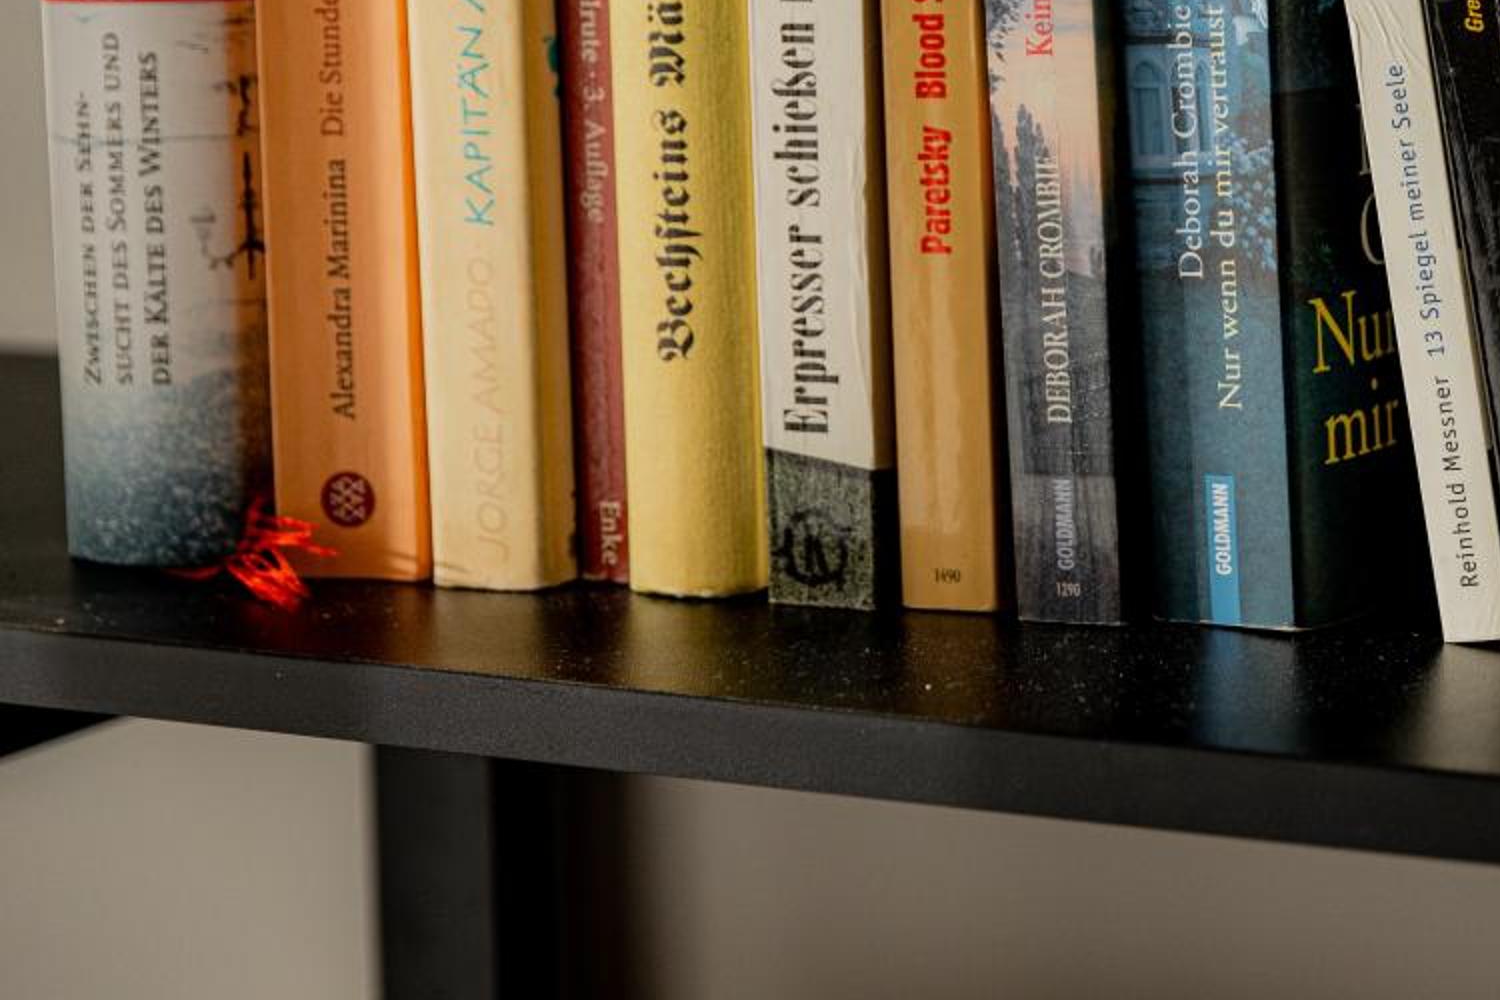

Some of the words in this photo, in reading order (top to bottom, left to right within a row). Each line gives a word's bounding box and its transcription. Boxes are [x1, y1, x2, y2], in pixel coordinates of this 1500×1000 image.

[101, 33, 121, 91] UND
[912, 14, 946, 99] Blood
[1166, 5, 1197, 139] Crombie
[1206, 4, 1231, 134] vertraust
[1385, 65, 1413, 129] Seele
[137, 51, 161, 177] WINTERS
[320, 92, 344, 137] Die
[457, 26, 496, 226] KAPITÄN
[771, 23, 821, 207] schießen
[77, 181, 96, 233] DER
[103, 97, 127, 232] SOMMERS
[142, 186, 163, 233] DES
[582, 121, 608, 223] Auflage
[918, 126, 952, 255] Paretsky
[1210, 145, 1233, 199] mir
[1396, 141, 1424, 220] meiner
[325, 160, 351, 280] Marinina
[1035, 156, 1066, 278] CROMBIE
[1173, 151, 1205, 280] Deborah
[1210, 209, 1236, 248] du
[109, 240, 130, 290] DES
[143, 243, 167, 325] KÄLTE
[1217, 258, 1239, 339] wenn
[1409, 230, 1441, 319] Spiegel
[81, 244, 102, 384] ZWISCHEN
[113, 298, 134, 384] SUCHT
[328, 289, 356, 420] Alexandra
[780, 224, 838, 434] Erpresser
[1041, 287, 1072, 425] DEBORAH
[1426, 330, 1445, 357] 13
[149, 333, 171, 386] DER
[1218, 350, 1244, 410] Nur
[1323, 376, 1400, 466] mir
[1431, 375, 1460, 472] Messner
[601, 501, 622, 565] Enke
[1053, 479, 1074, 570] GOLDMANN
[1212, 483, 1233, 575] GOLDMANN
[1445, 483, 1479, 587] Reinhold
